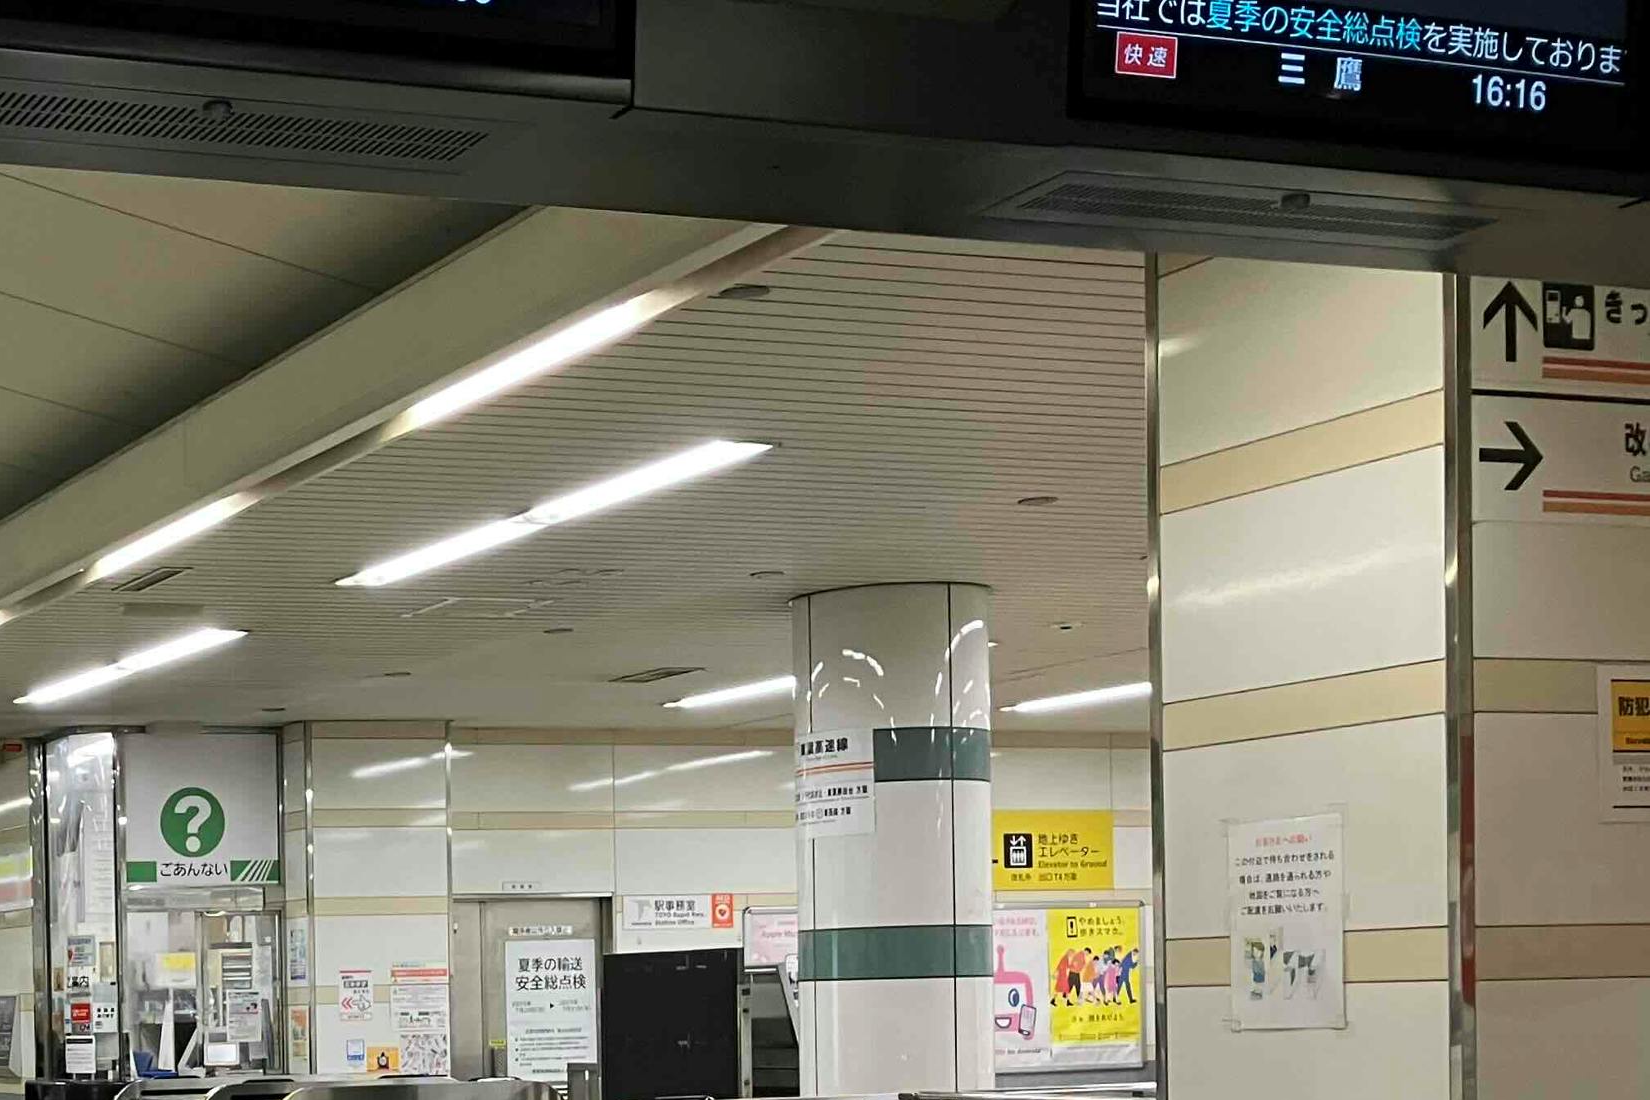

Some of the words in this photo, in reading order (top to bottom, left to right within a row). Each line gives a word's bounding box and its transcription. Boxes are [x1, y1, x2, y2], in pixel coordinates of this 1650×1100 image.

[1097, 0, 1627, 74] 当社では夏季の安全総点検を実施しておりま
[1124, 43, 1168, 68] 快速
[1278, 52, 1362, 92] 三鷹
[1472, 74, 1547, 110] 16:16
[1038, 833, 1078, 845] 地上ゆき
[1038, 847, 1100, 857] エレベーター
[160, 862, 228, 877] ごあんない
[518, 957, 583, 972] 夏季の輸送
[515, 974, 586, 991] 安全総点検
